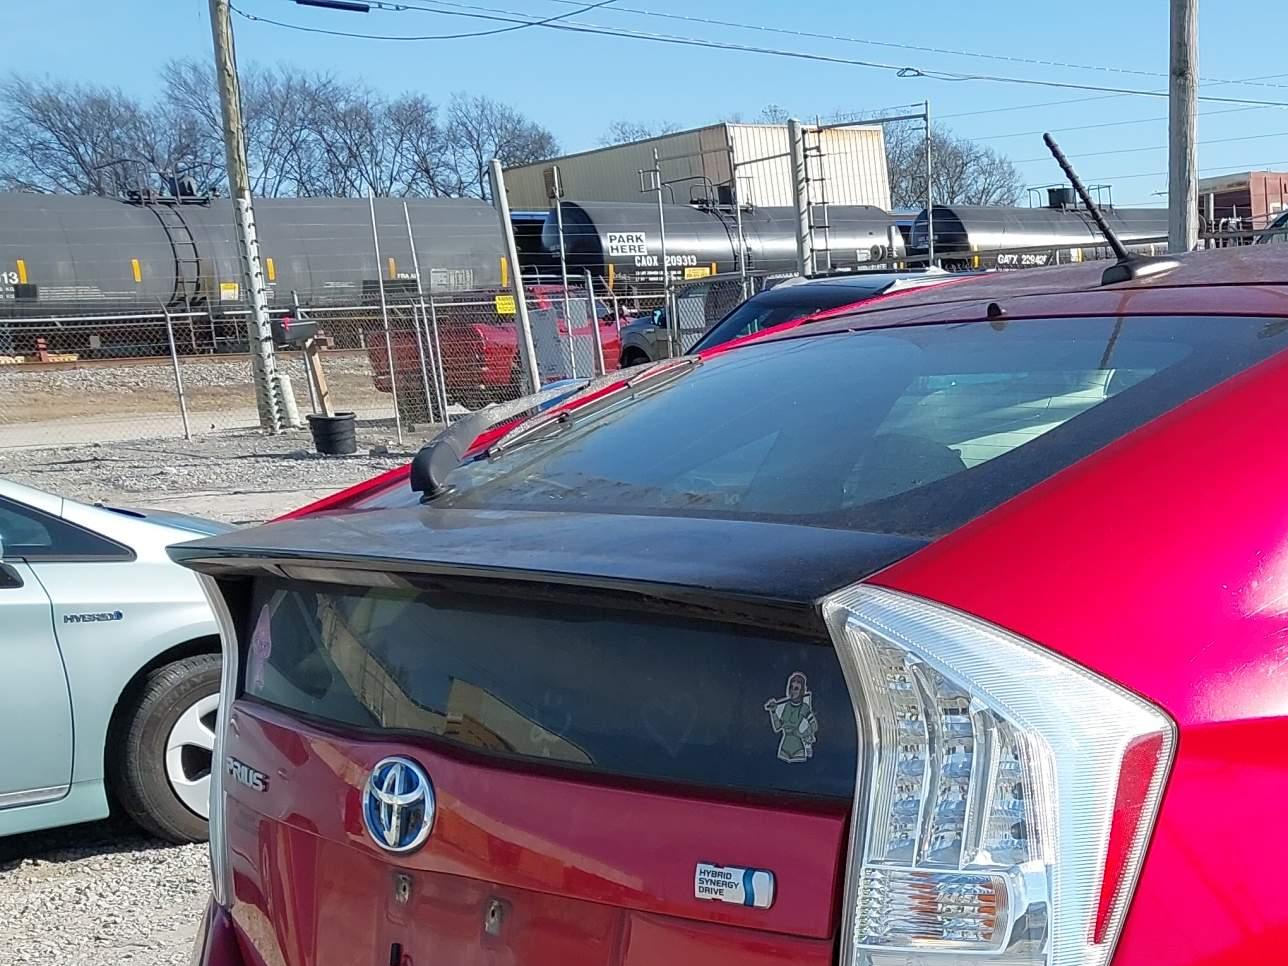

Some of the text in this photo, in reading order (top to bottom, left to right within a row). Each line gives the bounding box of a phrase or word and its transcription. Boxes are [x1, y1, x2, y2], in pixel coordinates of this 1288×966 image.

[609, 234, 644, 243] PARK
[610, 245, 646, 254] HERE
[665, 255, 697, 266] 209313
[997, 254, 1018, 265] GATX
[0, 271, 19, 285] 13
[63, 611, 114, 624] HYBRID
[226, 755, 267, 792] PRIUS
[699, 870, 732, 880] HYBRID
[698, 878, 739, 889] SYNERGY
[698, 886, 724, 896] DRIVE
